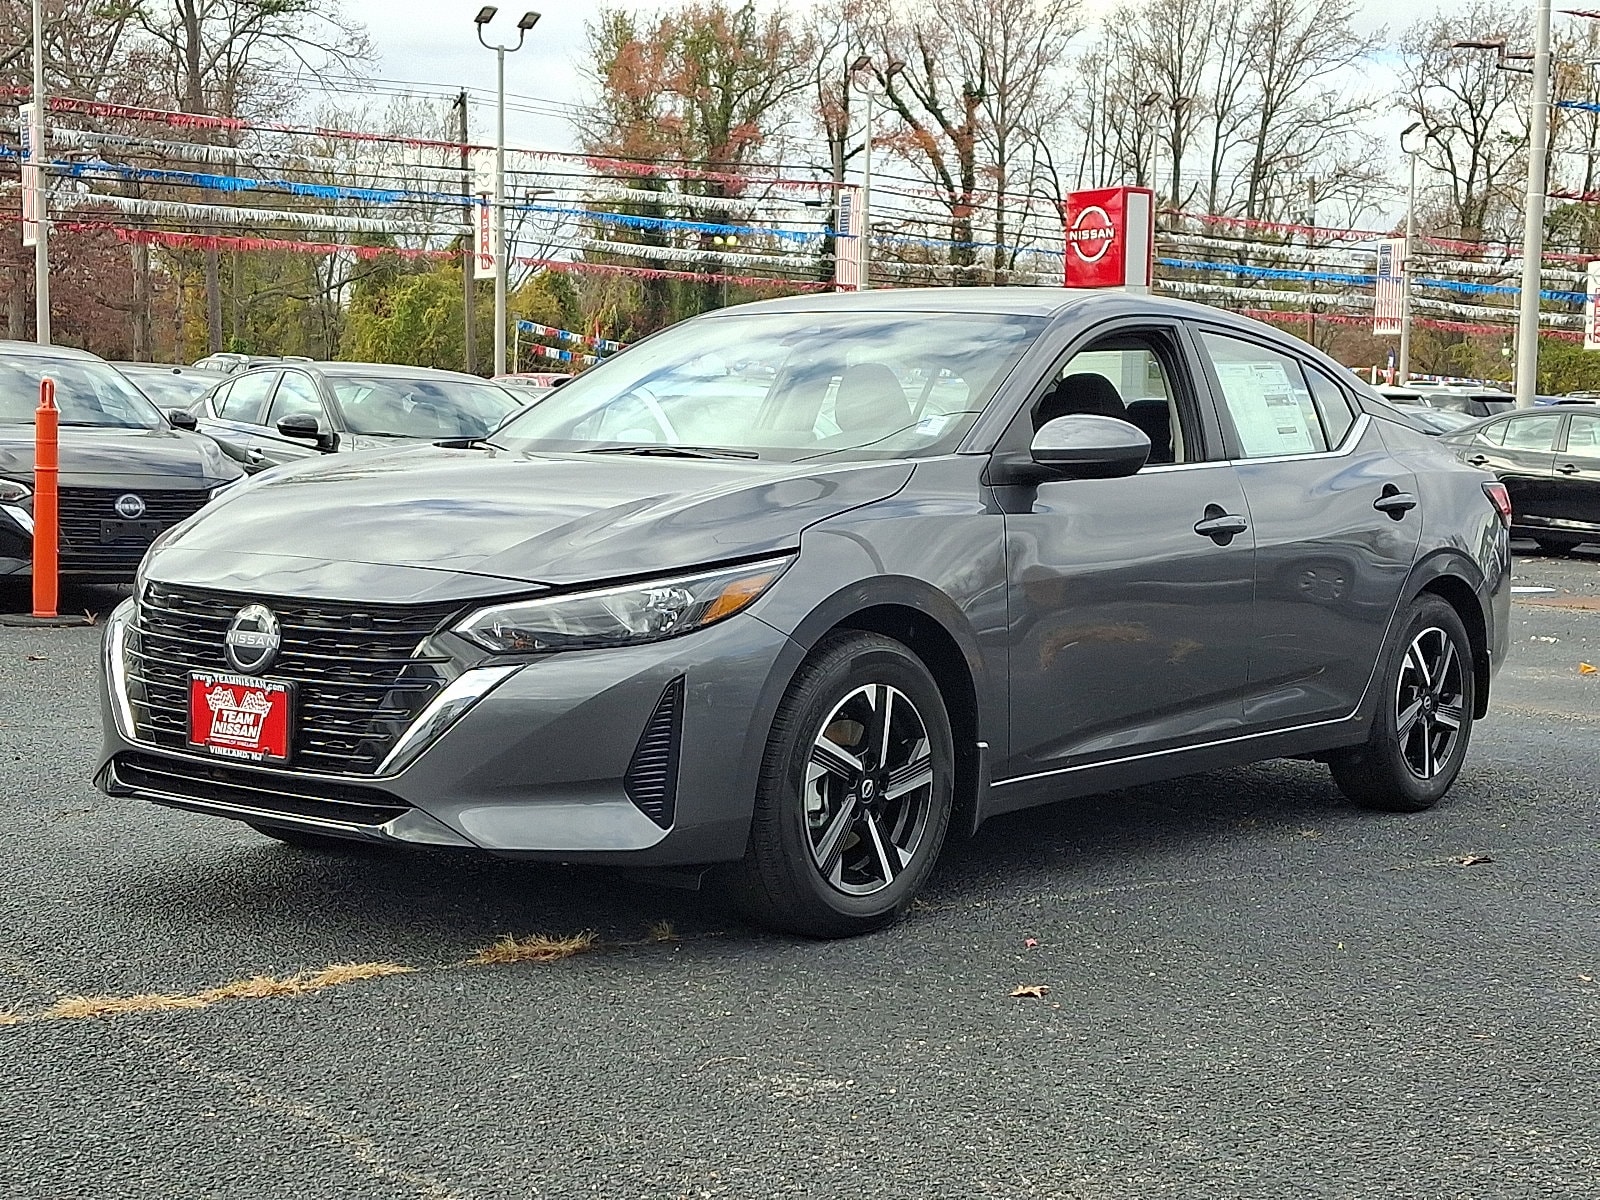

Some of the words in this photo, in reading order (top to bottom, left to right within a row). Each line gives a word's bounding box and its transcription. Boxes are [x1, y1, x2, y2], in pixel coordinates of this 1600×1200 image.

[1069, 228, 1115, 241] NISSAN
[226, 632, 277, 647] NISSAN
[222, 710, 254, 725] TEAM
[215, 720, 258, 738] NISSAN
